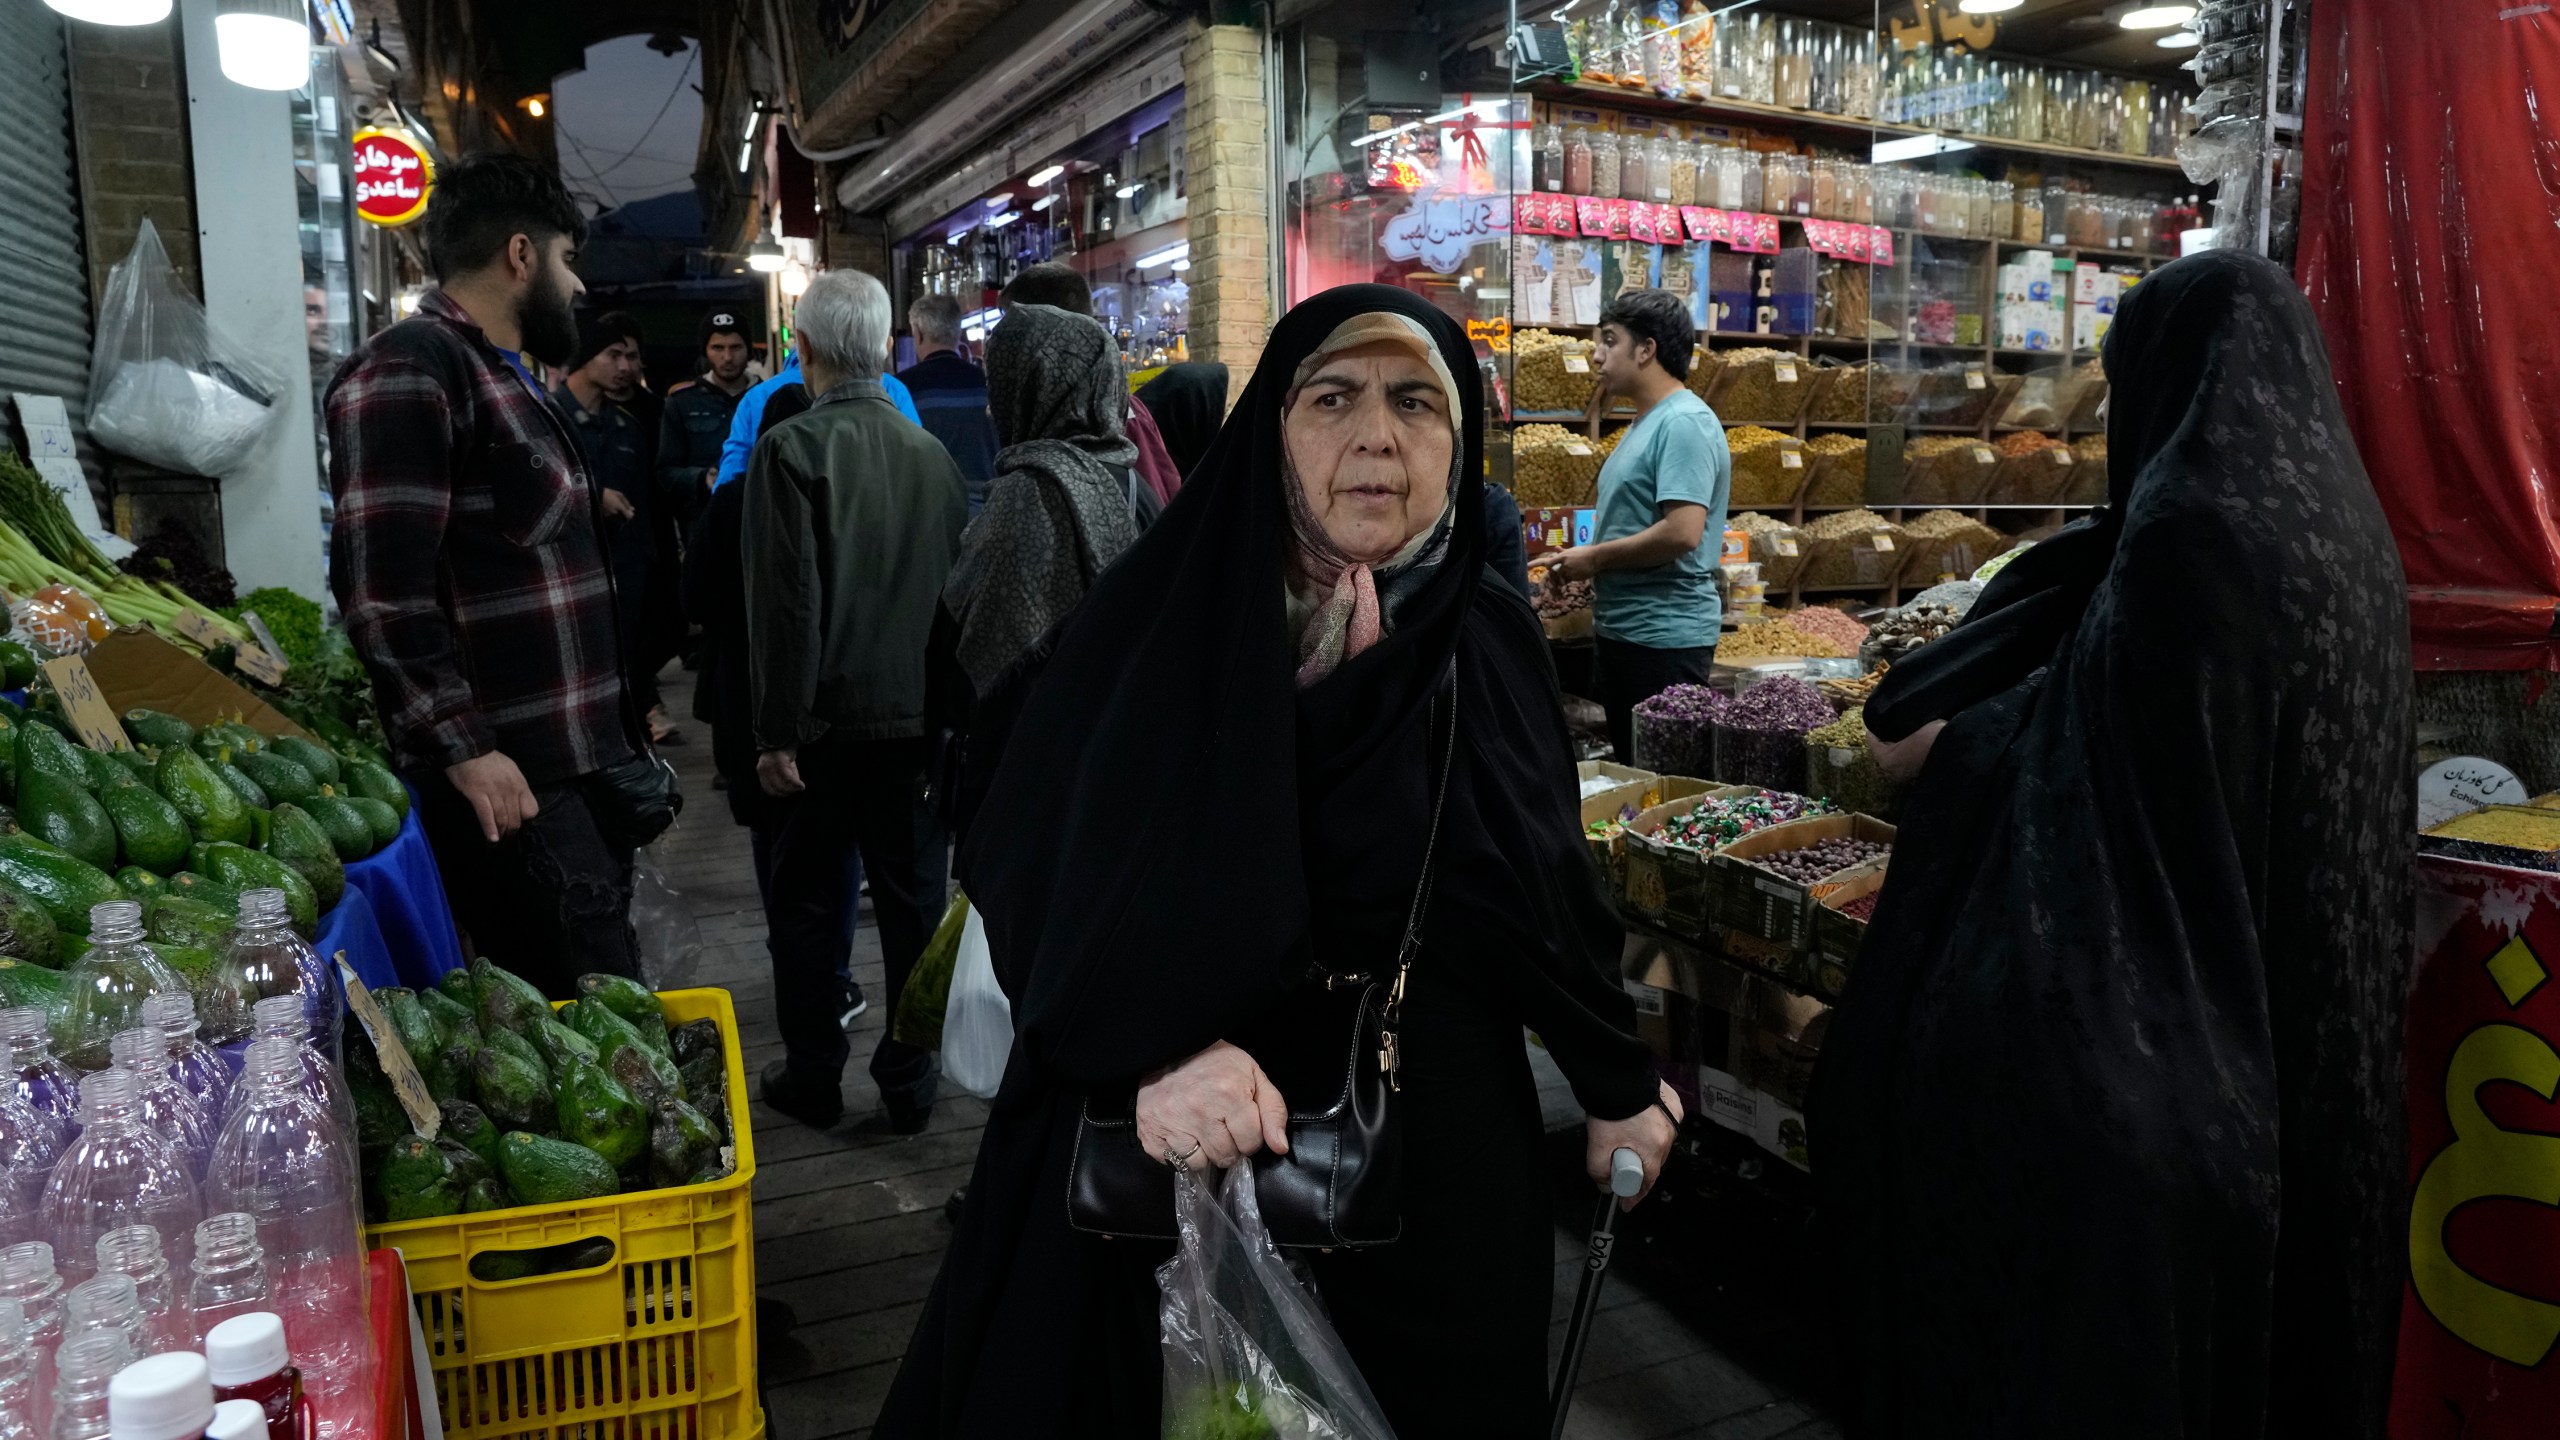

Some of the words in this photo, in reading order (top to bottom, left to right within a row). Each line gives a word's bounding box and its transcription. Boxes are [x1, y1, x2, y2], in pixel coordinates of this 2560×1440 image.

[354, 144, 420, 176] سوهان
[356, 177, 420, 203] ساعدی
[1716, 1091, 1753, 1115] Raisins
